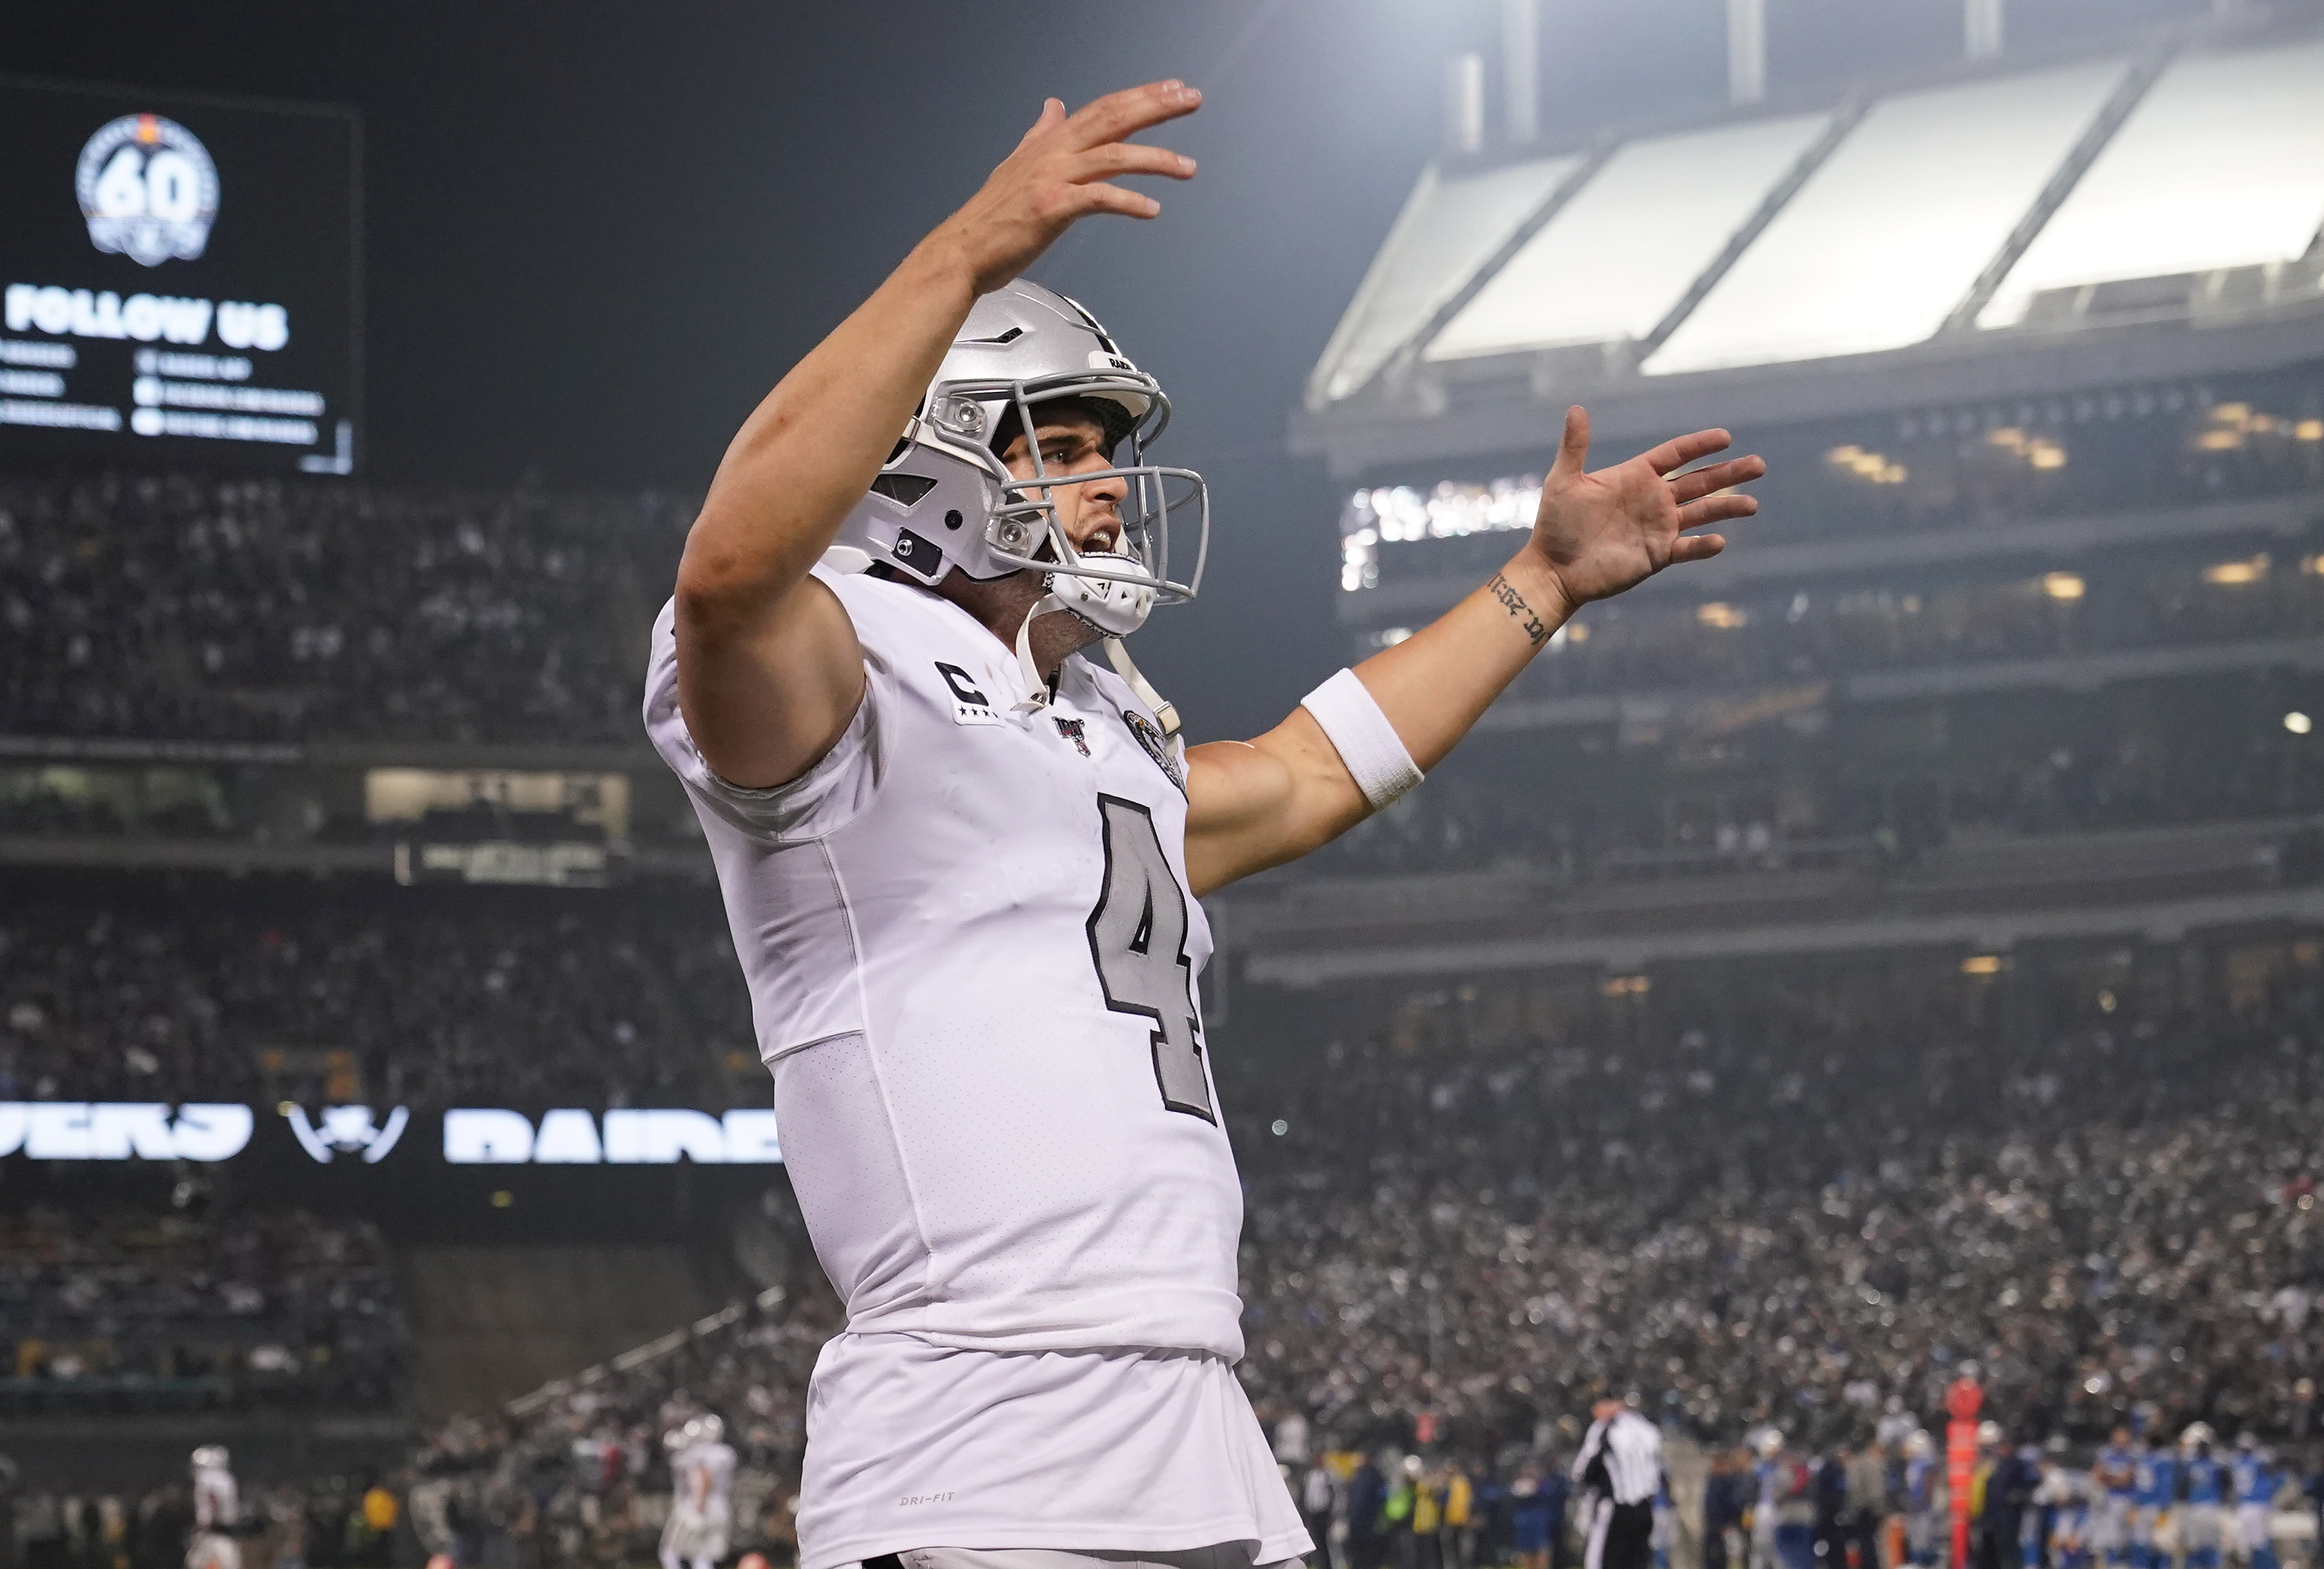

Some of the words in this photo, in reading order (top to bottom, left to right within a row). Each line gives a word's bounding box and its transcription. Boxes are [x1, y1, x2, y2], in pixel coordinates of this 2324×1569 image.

[96, 145, 198, 222] 60
[5, 282, 214, 345] FOLLOW
[216, 300, 289, 351] US
[934, 661, 990, 706] C
[1086, 792, 1218, 1127] 4
[444, 1108, 780, 1163] RAIDE
[899, 1492, 955, 1506] DRI-FIT
